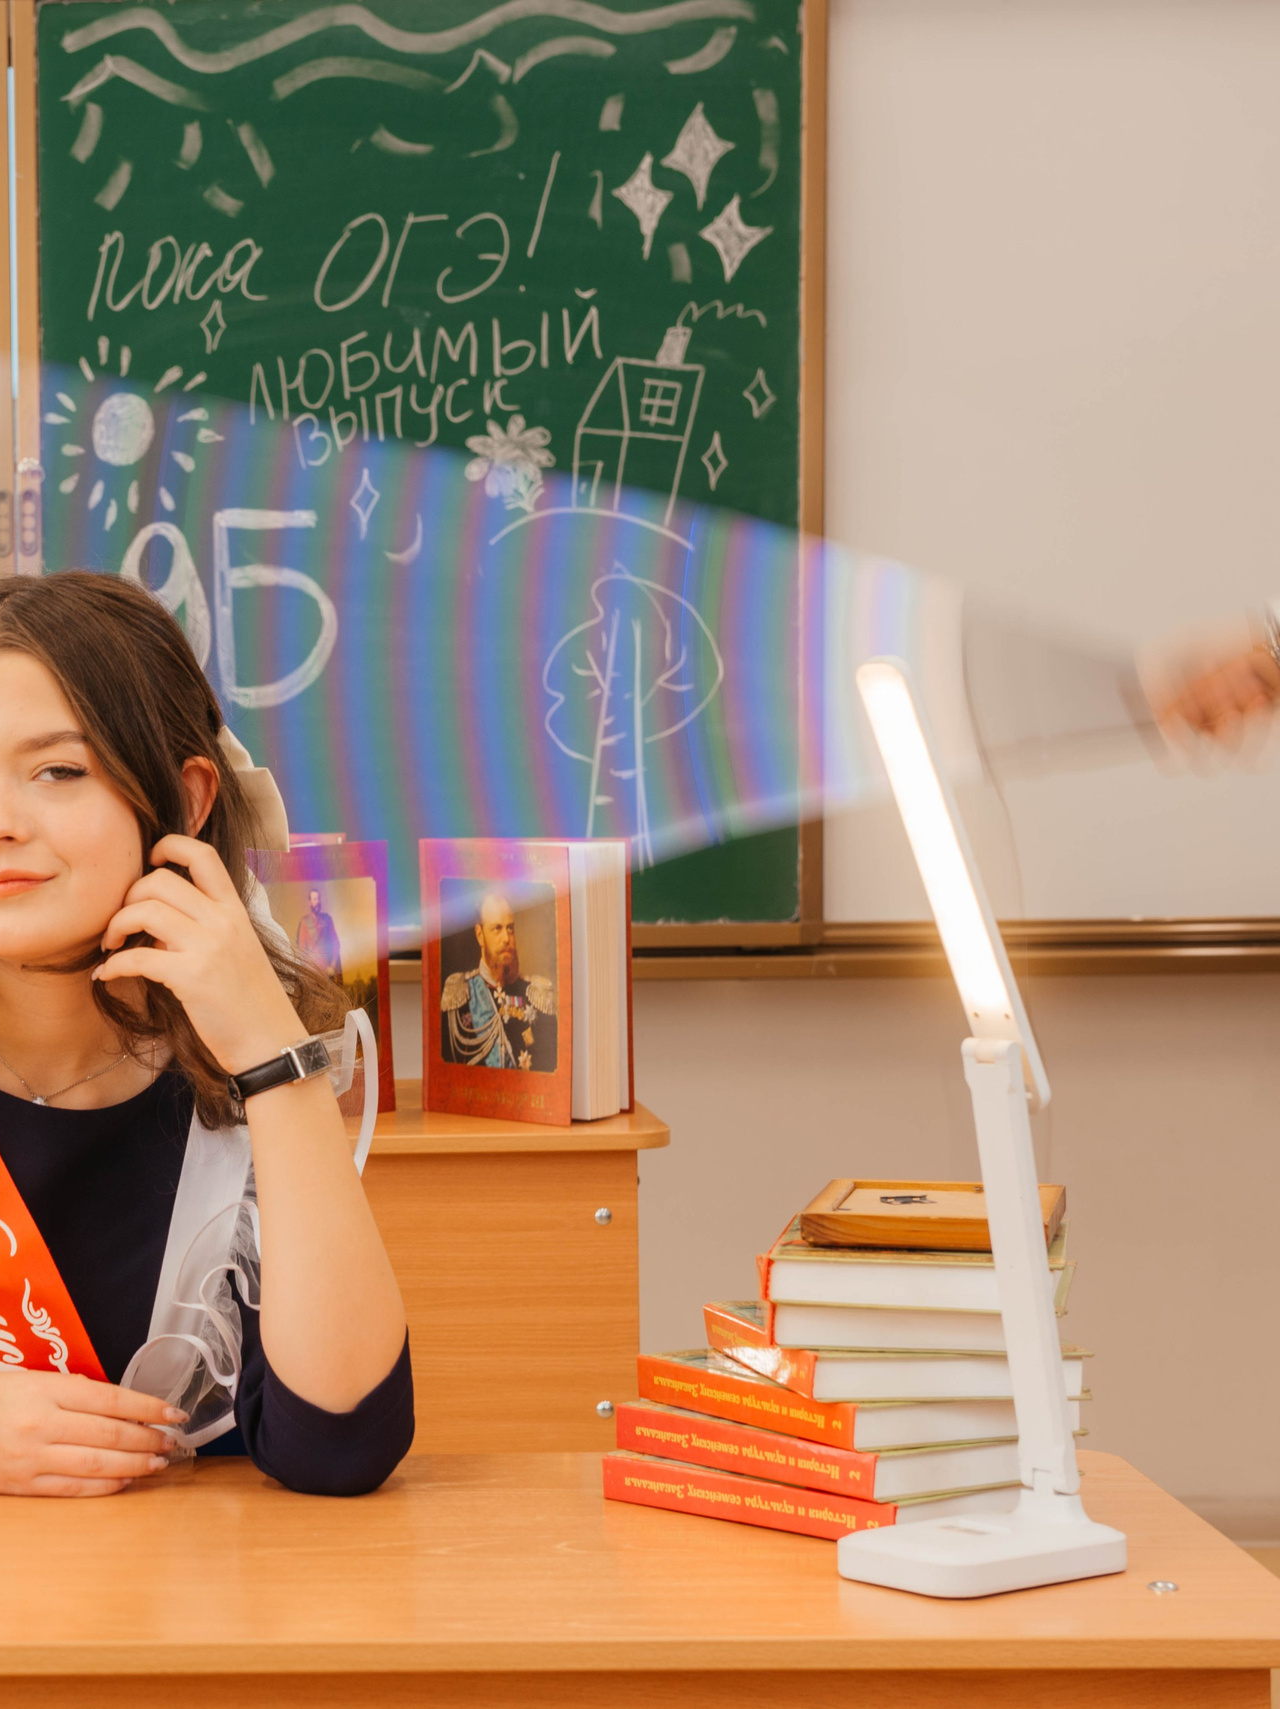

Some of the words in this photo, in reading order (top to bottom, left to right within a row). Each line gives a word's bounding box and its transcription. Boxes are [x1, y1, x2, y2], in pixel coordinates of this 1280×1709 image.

[314, 151, 561, 313] ОГЭ!
[249, 287, 603, 425] ЛЮБИМЫЙ
[293, 376, 520, 470] ВЫПУСК
[121, 508, 338, 709] 9Б
[635, 1425, 690, 1449] Забайкалья
[691, 1432, 739, 1456] семейских
[741, 1443, 787, 1466] культура
[797, 1457, 840, 1480] История
[624, 1475, 685, 1499] Забайкалья
[687, 1482, 742, 1507] семейских
[744, 1496, 795, 1515] культура
[809, 1508, 857, 1530] История
